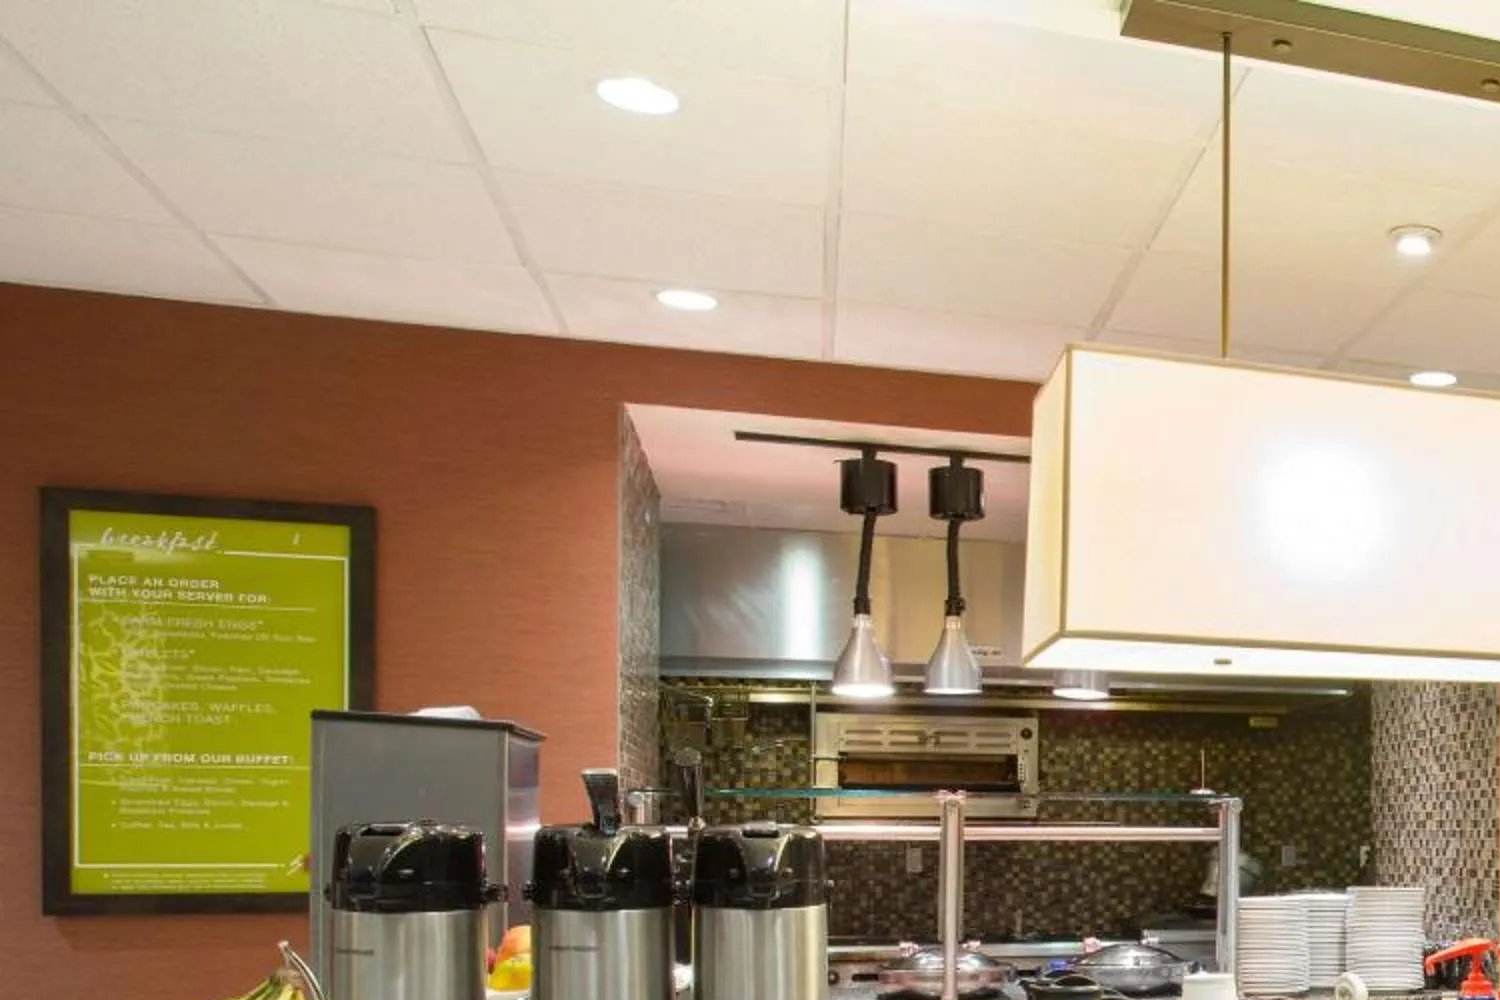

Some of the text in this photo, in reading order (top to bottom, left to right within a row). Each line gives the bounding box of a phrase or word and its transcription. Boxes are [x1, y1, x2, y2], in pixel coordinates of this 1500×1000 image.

[88, 574, 220, 589] PLACE AN ORDER
[88, 587, 127, 599] WITH
[132, 588, 173, 600] YOUR
[177, 590, 234, 603] SERVER
[88, 751, 124, 763] PICK
[129, 752, 149, 763] UP
[153, 753, 196, 764] FROM
[201, 753, 232, 764] OUR
